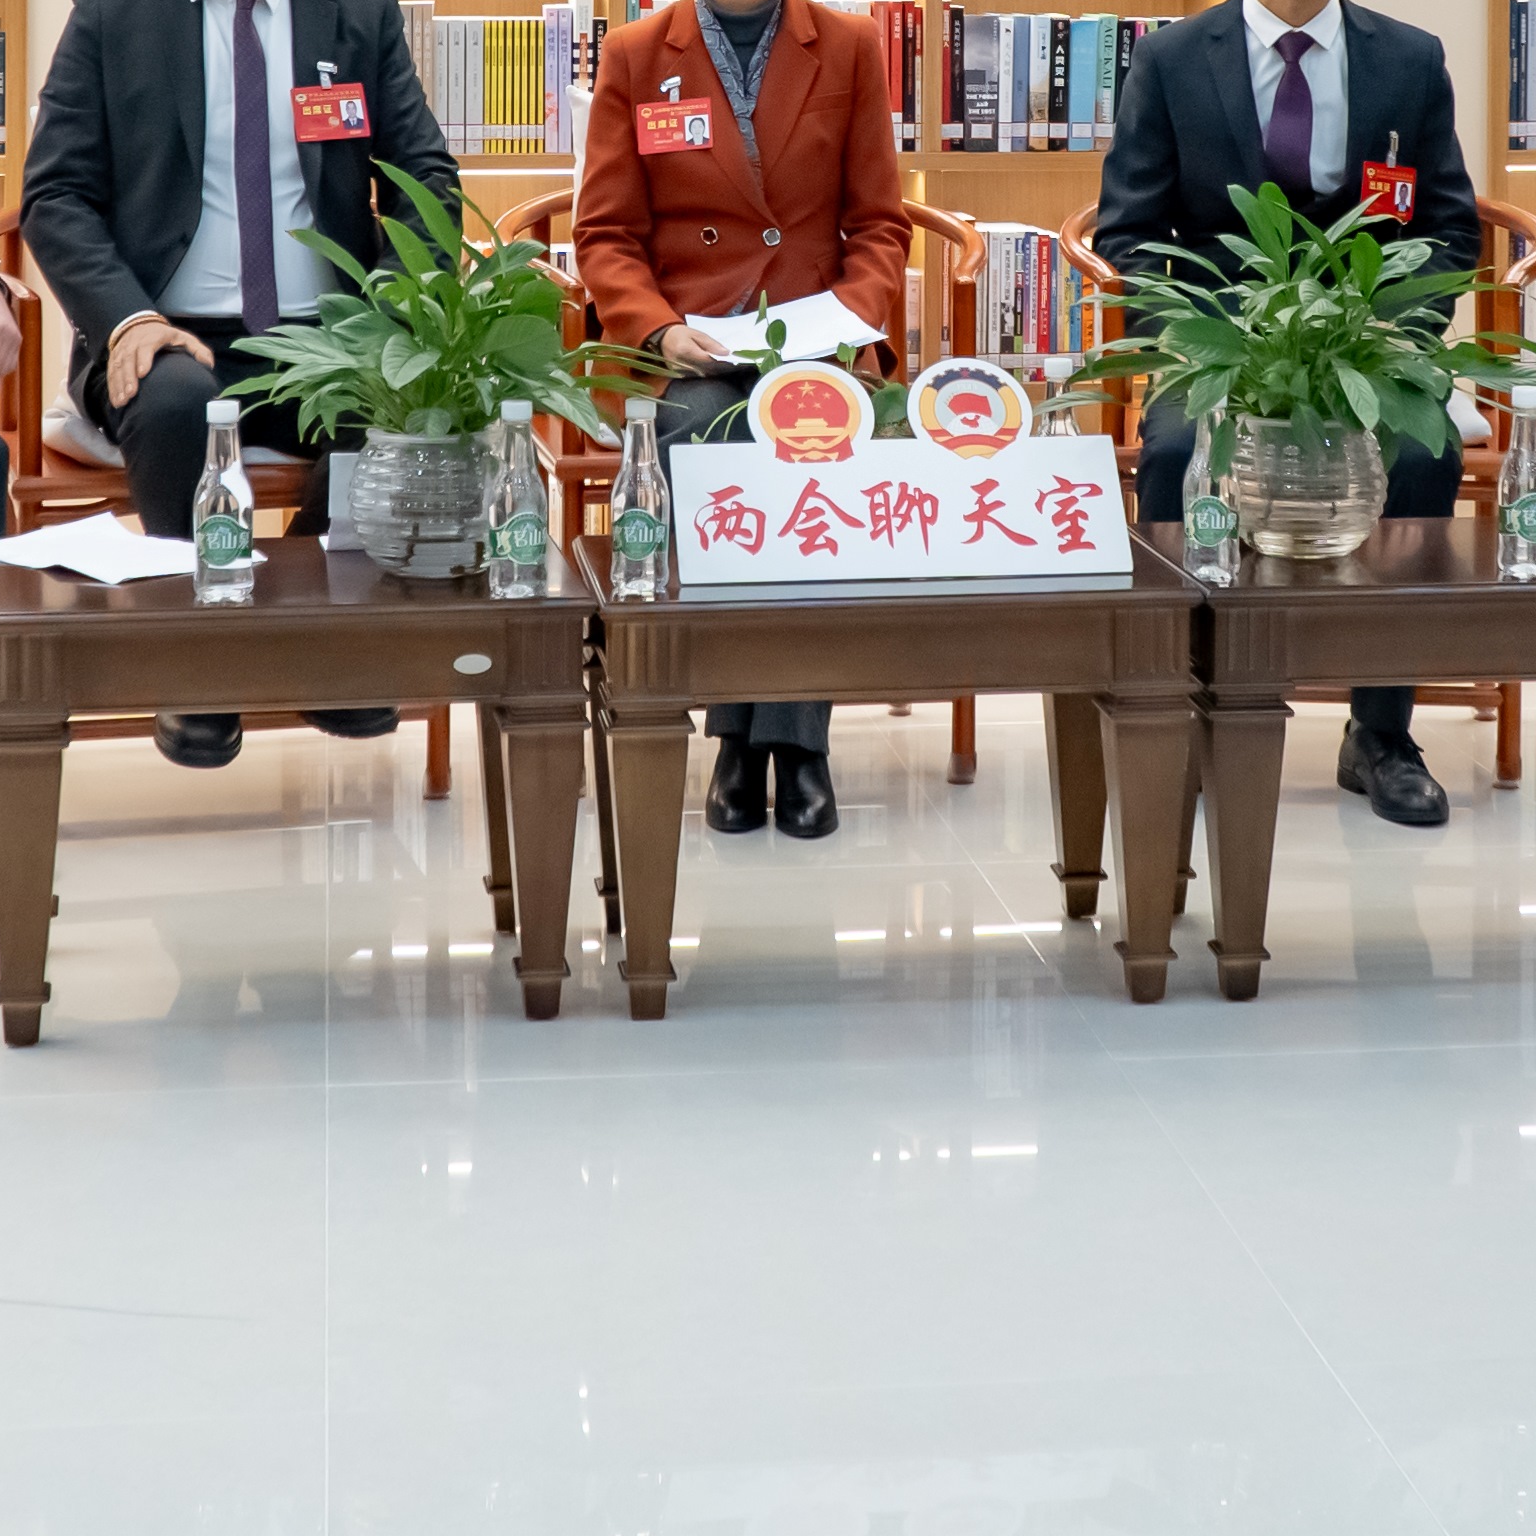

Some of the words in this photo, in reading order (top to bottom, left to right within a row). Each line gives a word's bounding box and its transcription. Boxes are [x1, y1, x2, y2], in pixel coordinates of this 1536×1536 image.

[693, 475, 1103, 557] 两会聊天室
